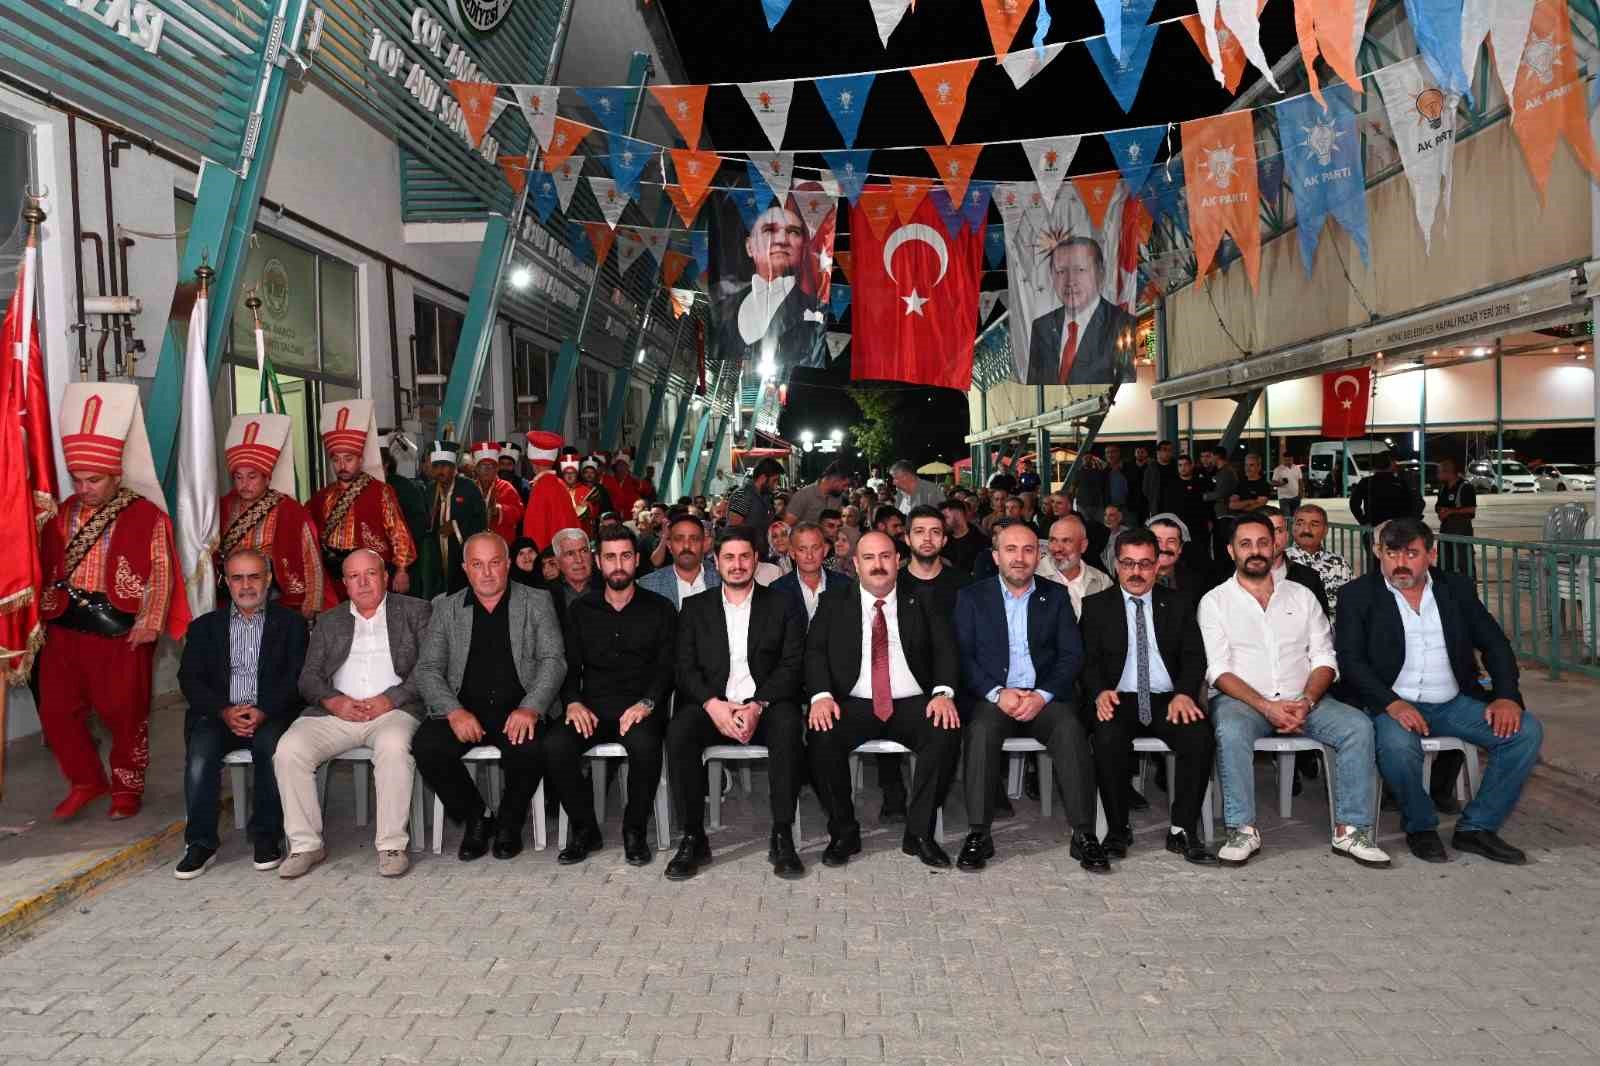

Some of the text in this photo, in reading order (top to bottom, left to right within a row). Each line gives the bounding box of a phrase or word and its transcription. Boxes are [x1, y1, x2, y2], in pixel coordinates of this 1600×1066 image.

[1417, 140, 1433, 152] AK
[1303, 175, 1319, 188] AK
[1201, 195, 1217, 208] AK
